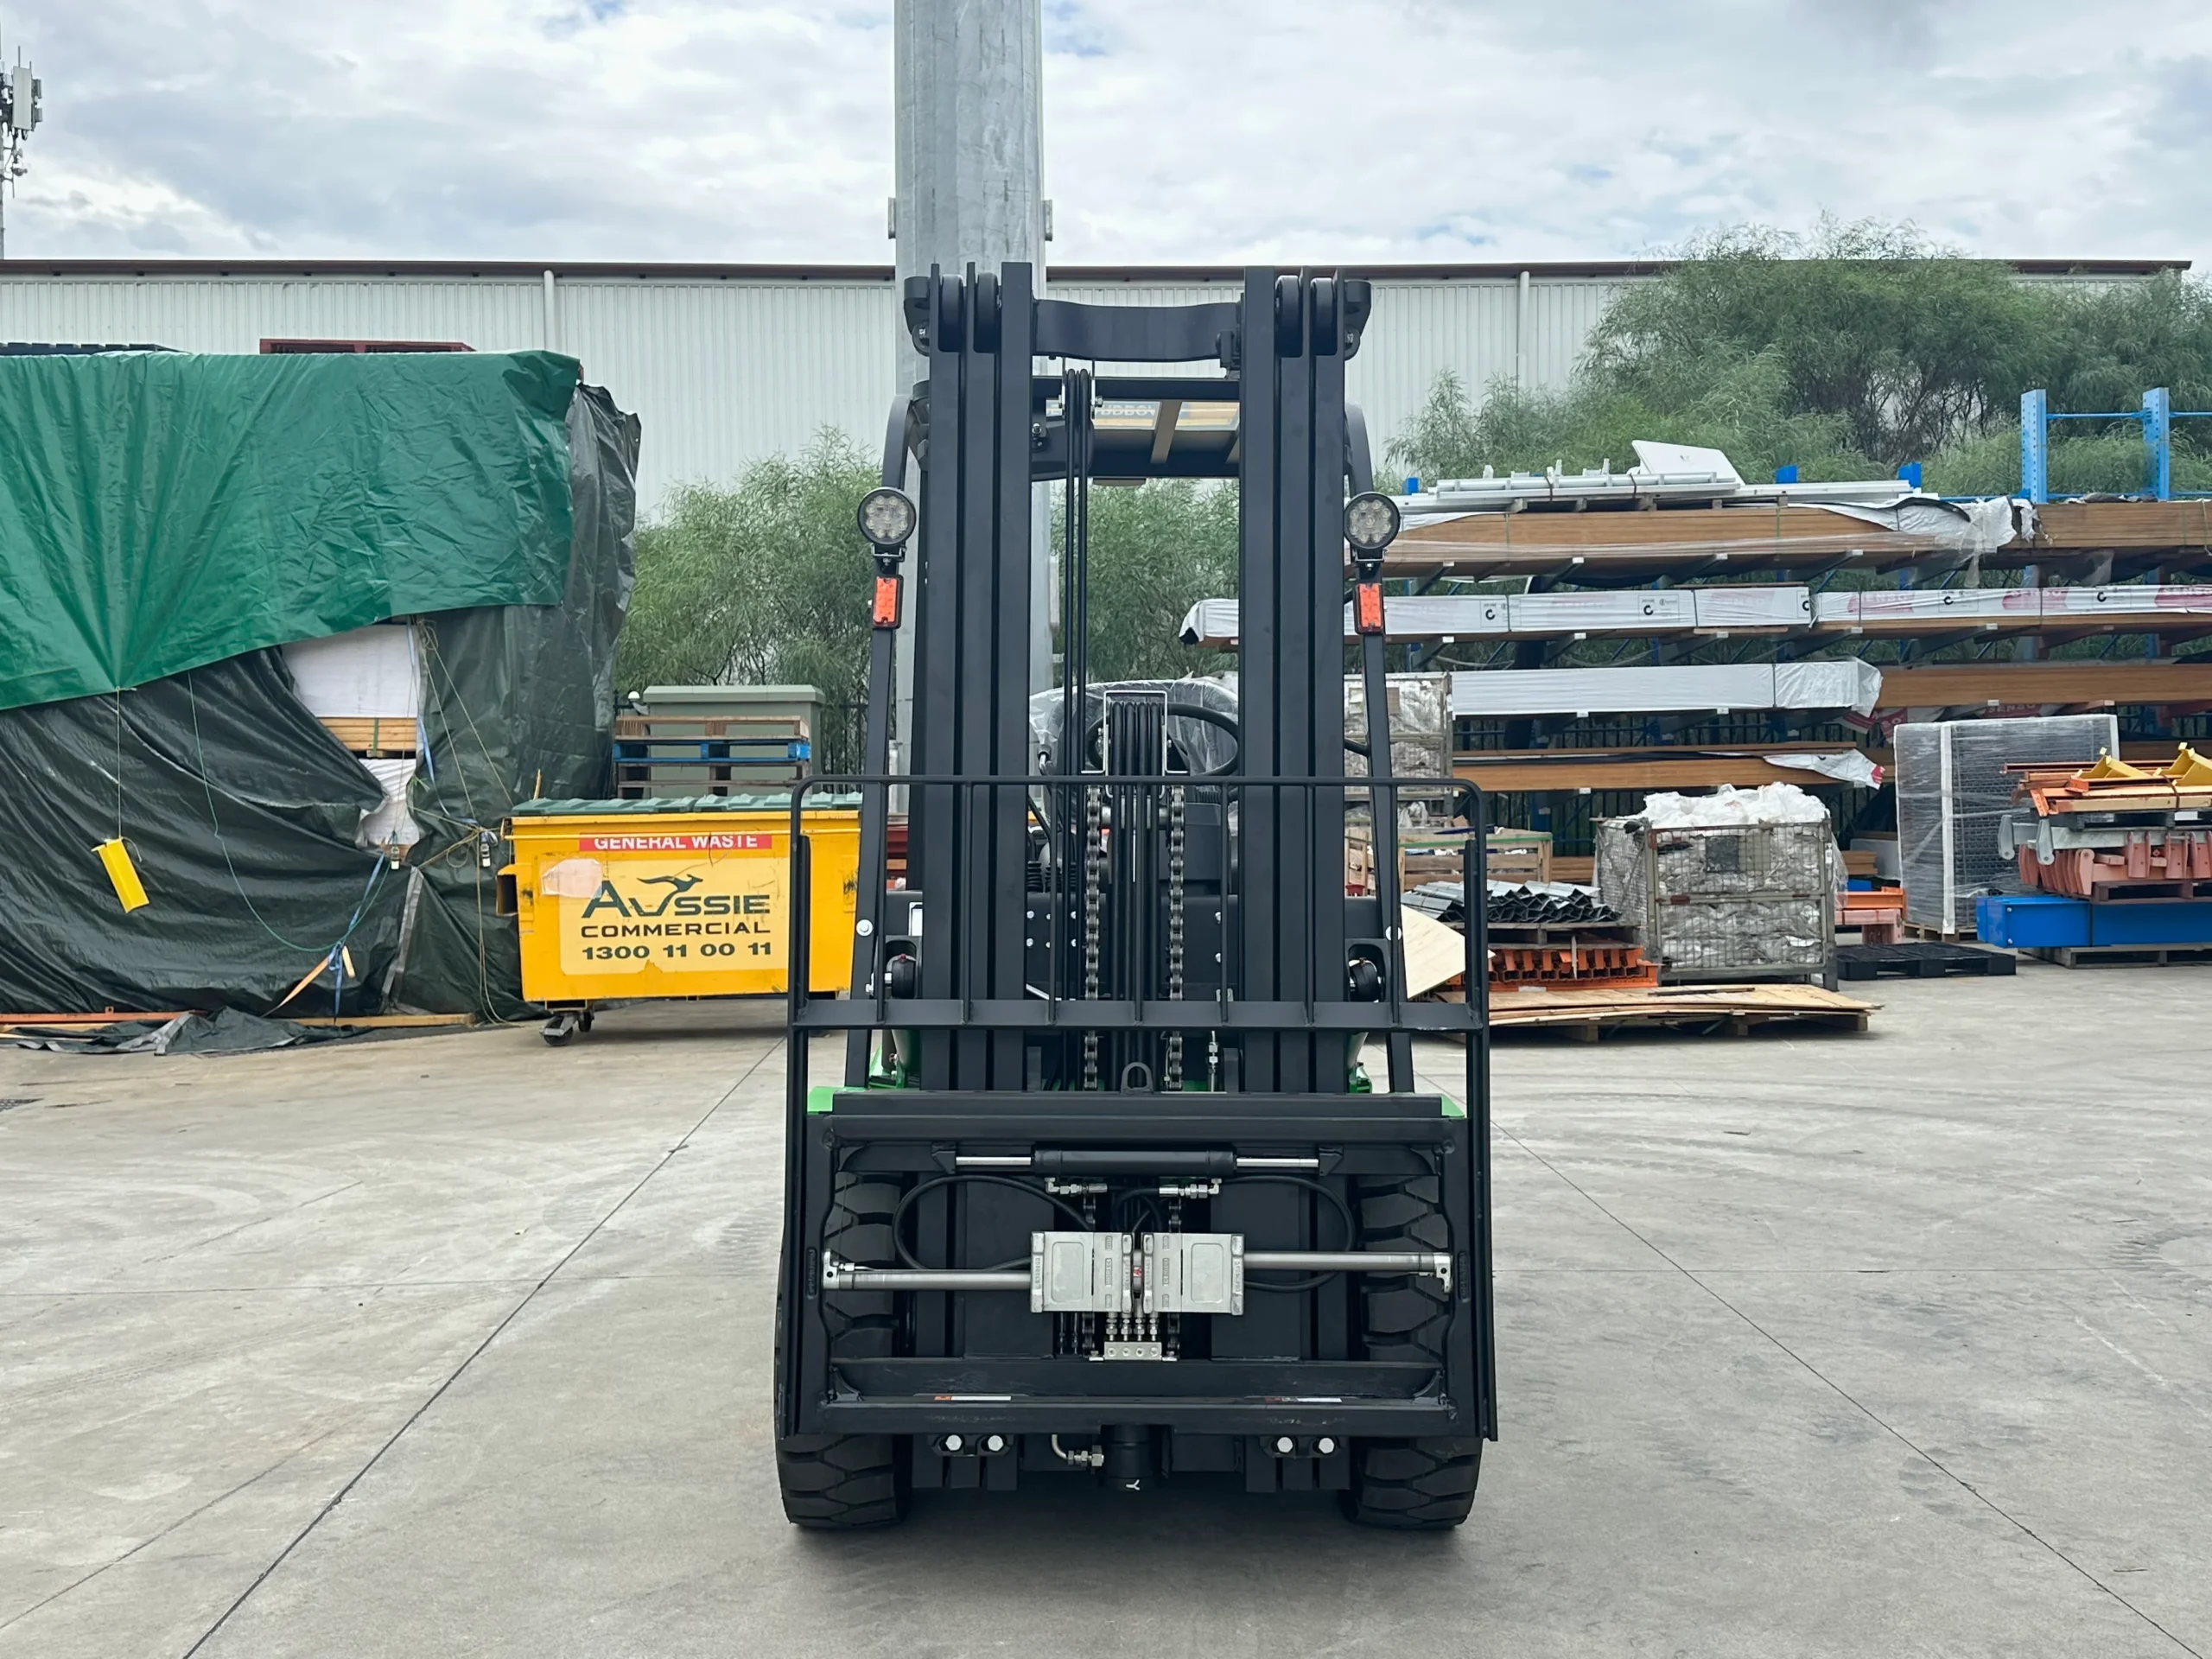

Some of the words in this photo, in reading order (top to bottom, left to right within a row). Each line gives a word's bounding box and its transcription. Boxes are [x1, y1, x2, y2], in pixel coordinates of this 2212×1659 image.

[594, 836, 686, 850] GENERAL
[692, 835, 759, 849] WASTE
[581, 921, 771, 938] COMMERCIAL
[582, 945, 651, 960] 1300
[663, 944, 688, 958] 11
[700, 943, 735, 957] 00
[747, 942, 772, 956] 11
